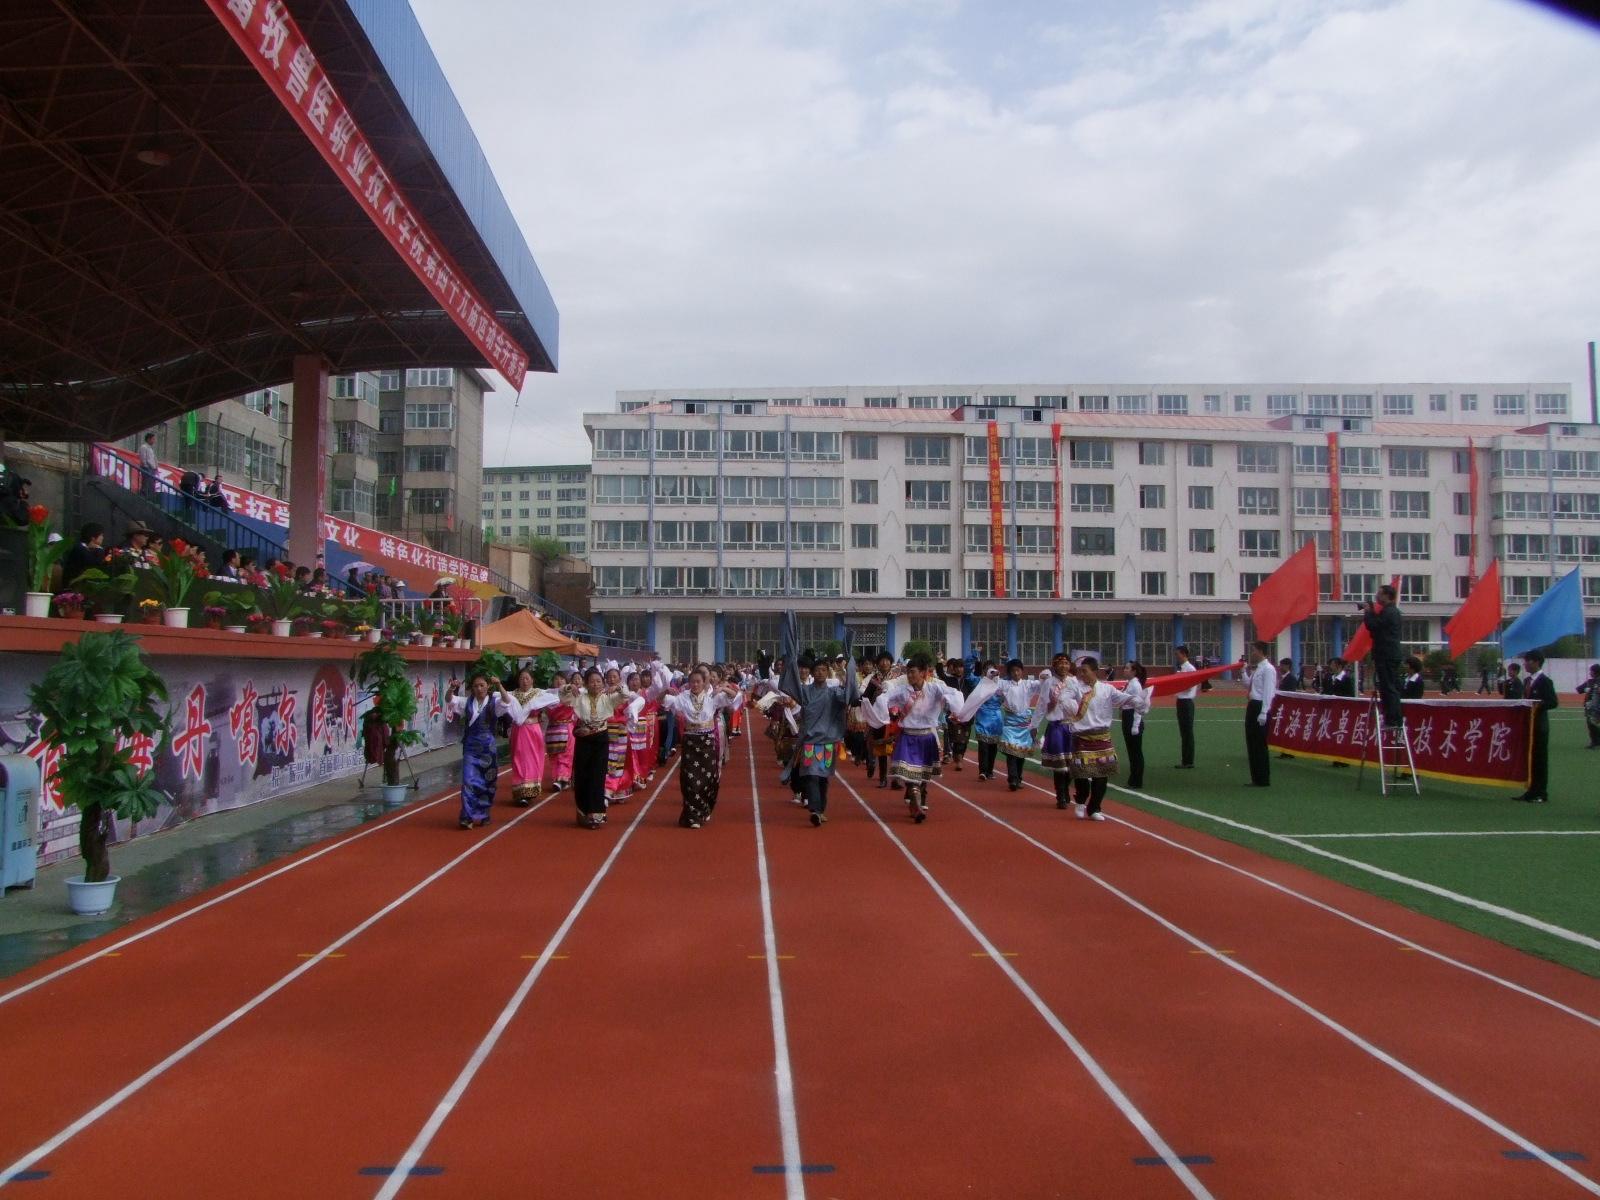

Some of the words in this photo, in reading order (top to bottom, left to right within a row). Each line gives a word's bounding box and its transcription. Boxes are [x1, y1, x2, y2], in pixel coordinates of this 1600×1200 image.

[1272, 703, 1511, 763] 青海畜牧兽医技术学院
